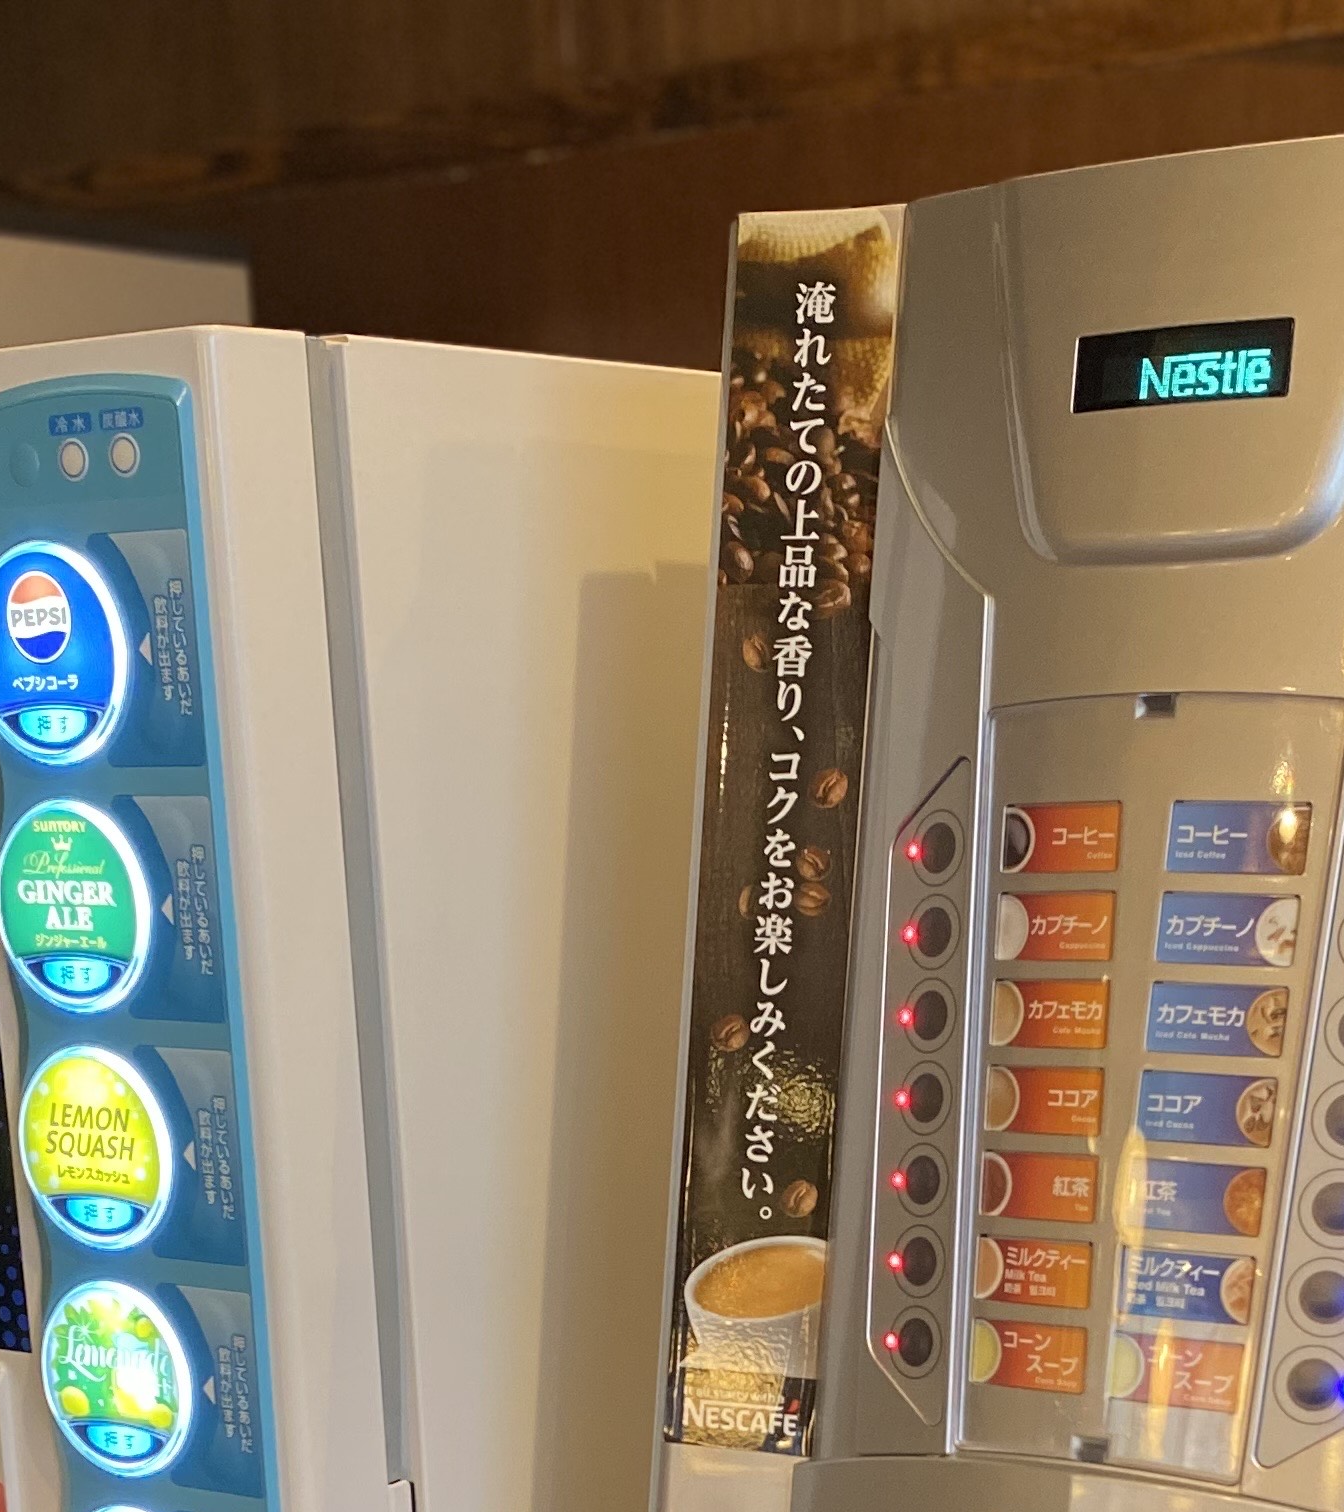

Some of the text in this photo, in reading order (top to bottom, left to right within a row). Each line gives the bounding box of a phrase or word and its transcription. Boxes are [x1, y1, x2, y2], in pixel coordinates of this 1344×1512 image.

[10, 606, 68, 627] PEPSI
[12, 674, 79, 691] ペプシコーラ
[1051, 826, 1116, 846] コーヒー
[1176, 824, 1249, 846] コーヒー
[16, 879, 117, 907] GINGER
[45, 906, 94, 931] ALE
[1030, 914, 1108, 936] カプチーノ
[1165, 913, 1256, 939] カプチーノ
[35, 933, 107, 950] ジンジャーエール
[1027, 999, 1104, 1021] カフェモカ
[1156, 1003, 1246, 1028] カフェモカ
[1047, 1089, 1099, 1108] ココア
[1147, 1094, 1204, 1114] ココア
[49, 1102, 130, 1132] LEMON
[45, 1131, 135, 1161] SQUASH
[57, 1164, 131, 1185] レモンスカッシュ
[1053, 1176, 1090, 1198] 紅茶
[1006, 1245, 1087, 1271] ミルクティー
[1129, 1254, 1221, 1282] ミルクティー
[1003, 1331, 1051, 1352] コーン
[1026, 1354, 1079, 1376] スープ
[1174, 1370, 1234, 1394] スープ
